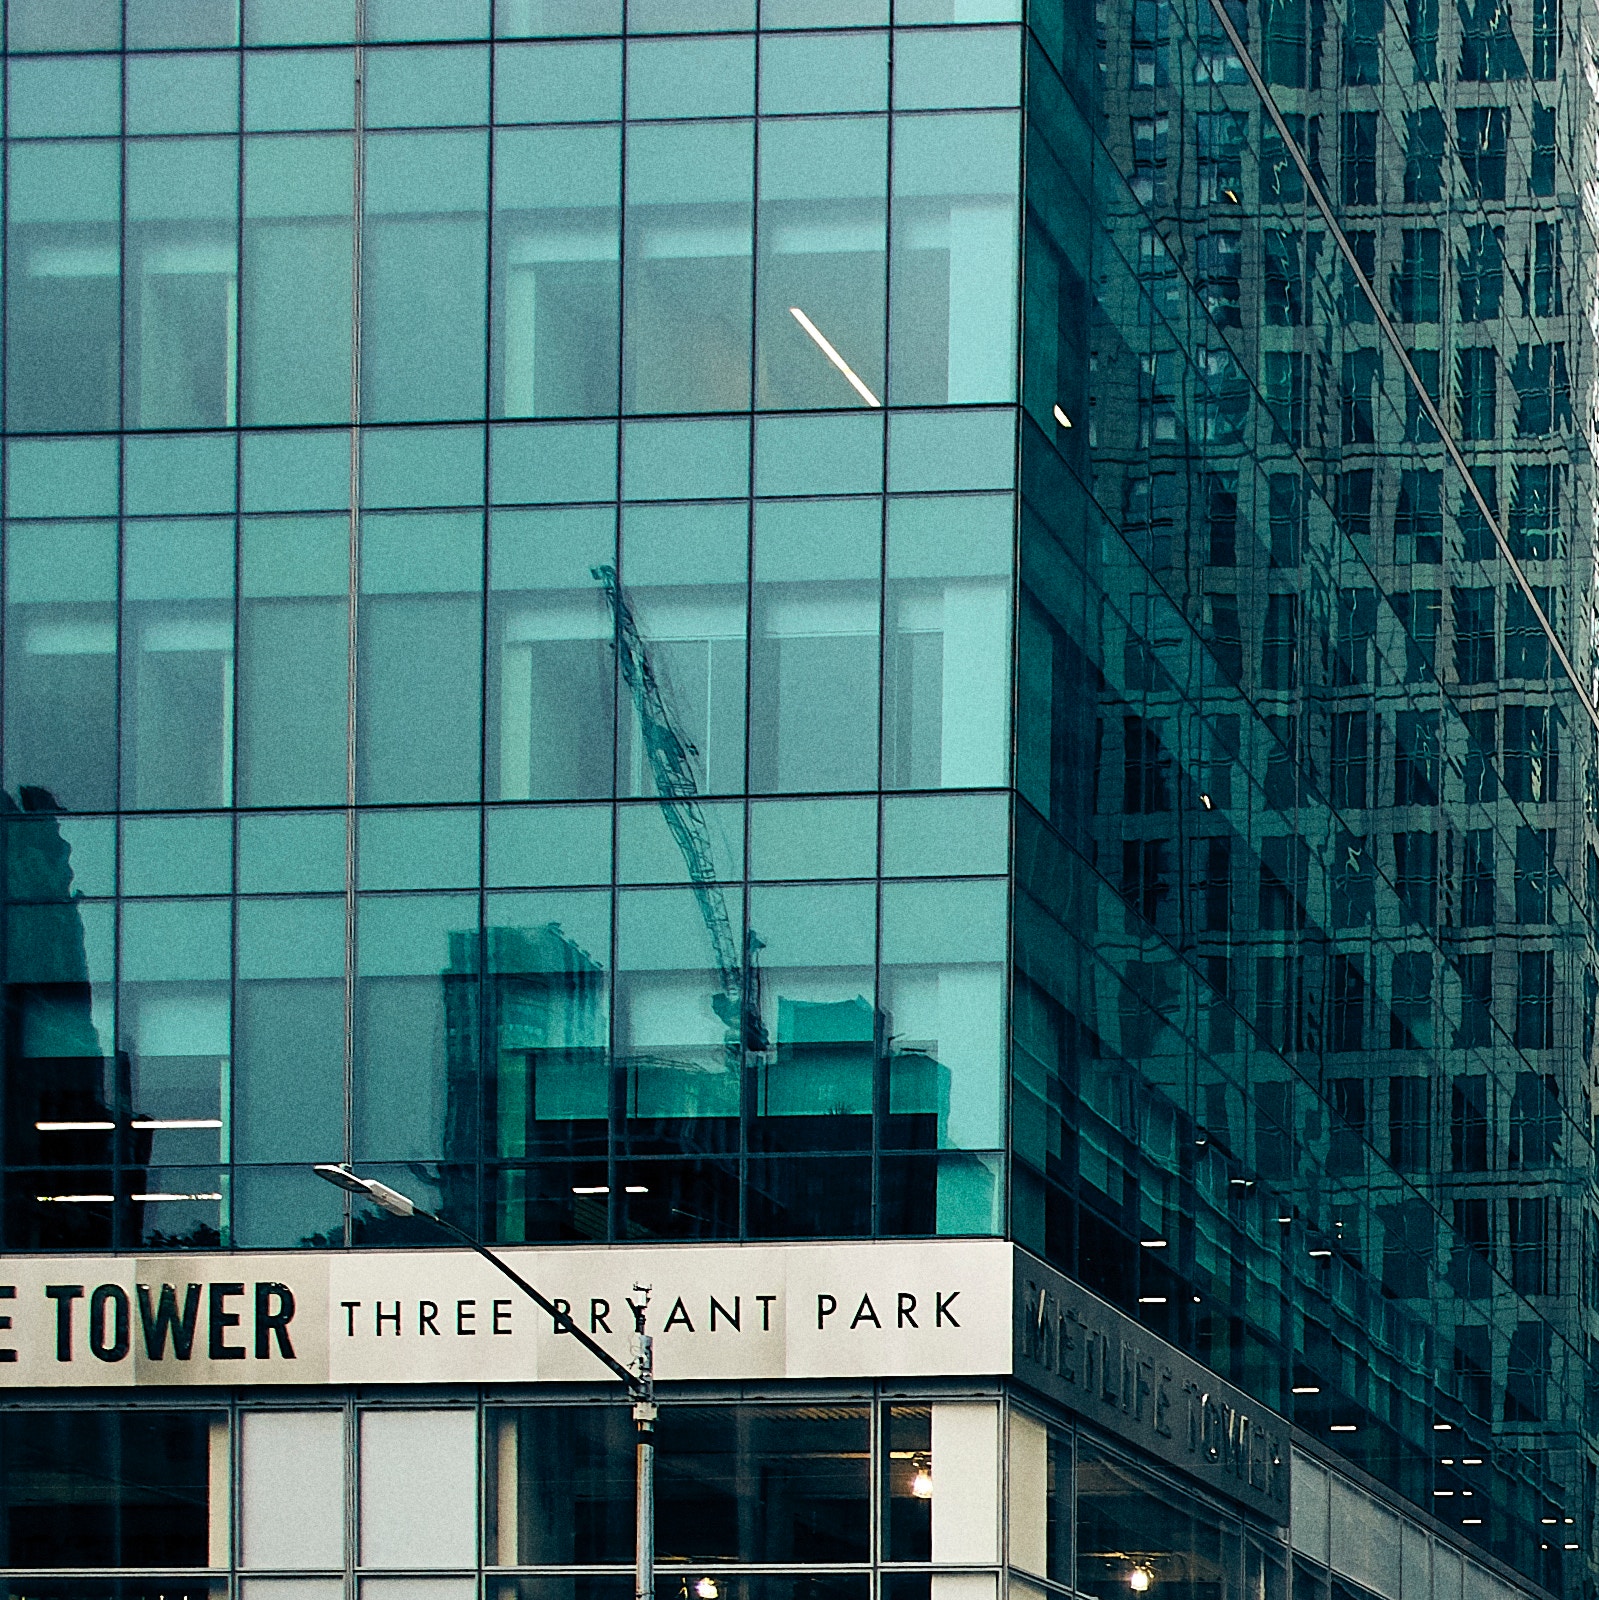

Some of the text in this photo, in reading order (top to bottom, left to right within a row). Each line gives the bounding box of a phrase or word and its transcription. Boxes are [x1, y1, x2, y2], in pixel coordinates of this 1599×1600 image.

[46, 1282, 296, 1362] TOWER
[341, 1291, 961, 1336] THREE BRYANT PARK
